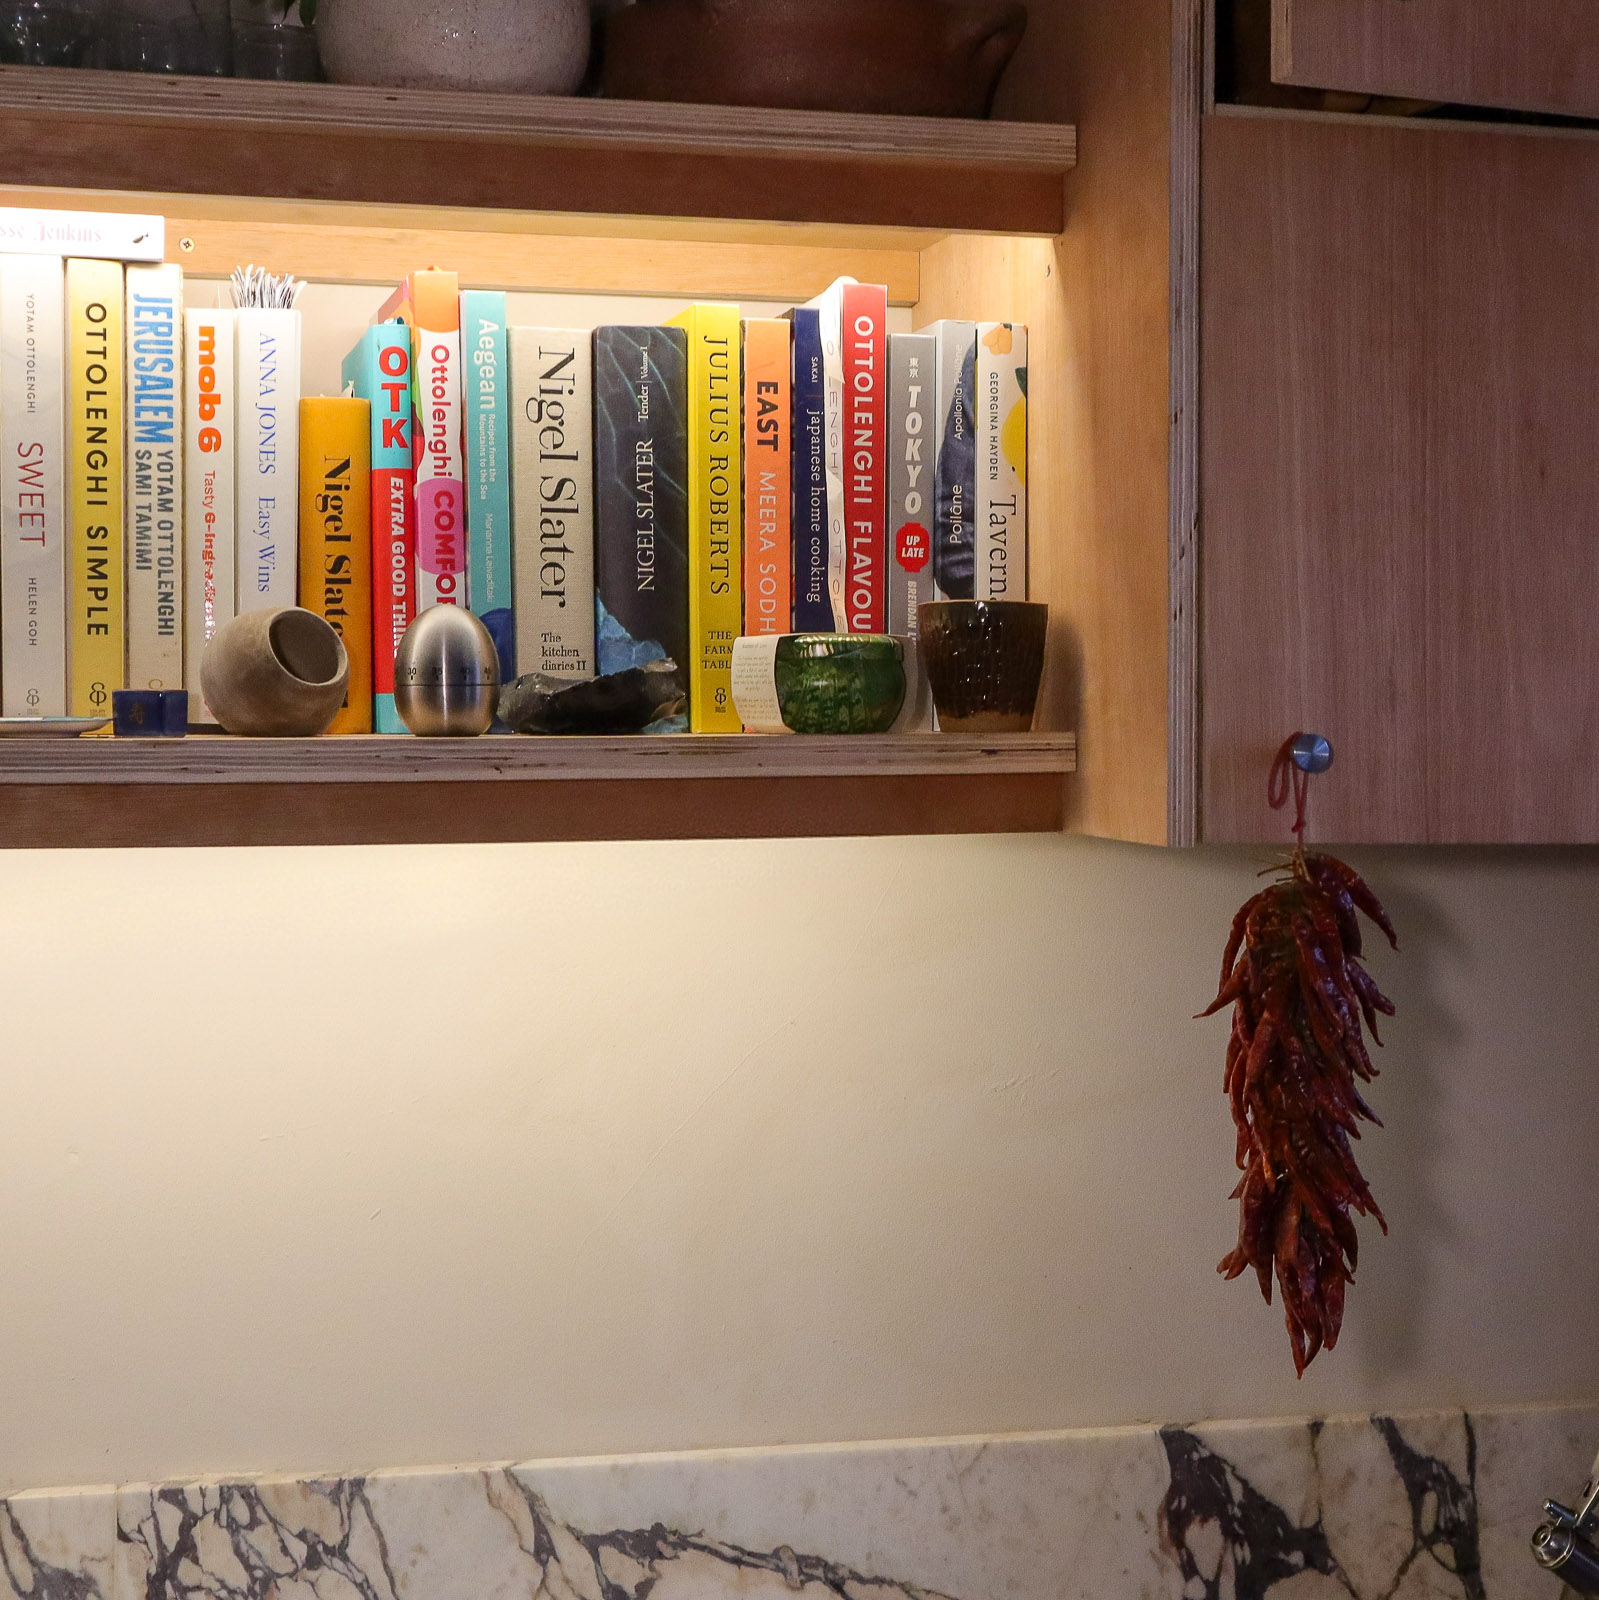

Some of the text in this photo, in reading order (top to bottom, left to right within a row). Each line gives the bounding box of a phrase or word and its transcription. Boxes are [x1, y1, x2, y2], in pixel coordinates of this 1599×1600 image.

[26, 293, 36, 414] YOTAM OTTOLENGHI
[133, 294, 174, 443] JERUSALEM
[198, 326, 222, 453] mob 6
[379, 346, 409, 449] OTK
[474, 318, 499, 409] Aegean
[640, 352, 648, 380] Volume
[811, 356, 819, 383] SAKAI
[255, 333, 276, 474] ANNA JONES
[488, 413, 497, 482] Recipes from the
[637, 385, 649, 423] Tender
[757, 381, 778, 452] EAST
[905, 385, 923, 515] TOKYO
[953, 388, 964, 440] Apollonia
[989, 371, 999, 480] GEORGINA HAYDEN
[17, 442, 45, 547] SWEET
[86, 303, 108, 636] OTTOLENGHI SIMPLE
[202, 470, 216, 509] Tasty
[315, 455, 352, 544] Nigel
[428, 345, 457, 605] Ottolenghi COMFO
[479, 413, 488, 500] Mountains to the Sea
[526, 346, 579, 608] Nigel Slater
[703, 335, 730, 595] JULIUS ROBERTS
[806, 408, 825, 603] japanese home cooking
[852, 315, 874, 630] OTTOLENGHI FLAVOU
[135, 450, 152, 571] SAMI TAMIMI
[156, 450, 175, 636] YOTAM OTTOLENGHI
[253, 496, 276, 592] Easy Wins
[636, 438, 655, 591] NIGEL SLATER
[759, 471, 777, 632] MEERA SODH
[901, 548, 924, 558] LATE
[906, 535, 920, 546] UP
[949, 484, 963, 544] Poilâne
[989, 494, 1016, 600] Tavern
[28, 577, 37, 646] HELEN GOH
[390, 477, 407, 659] EXTRA GOOD THIN
[907, 580, 917, 629] BRENDAN
[541, 632, 562, 643] The
[541, 646, 580, 657] kitchen
[541, 660, 587, 671] diaries II
[707, 631, 732, 640] THE
